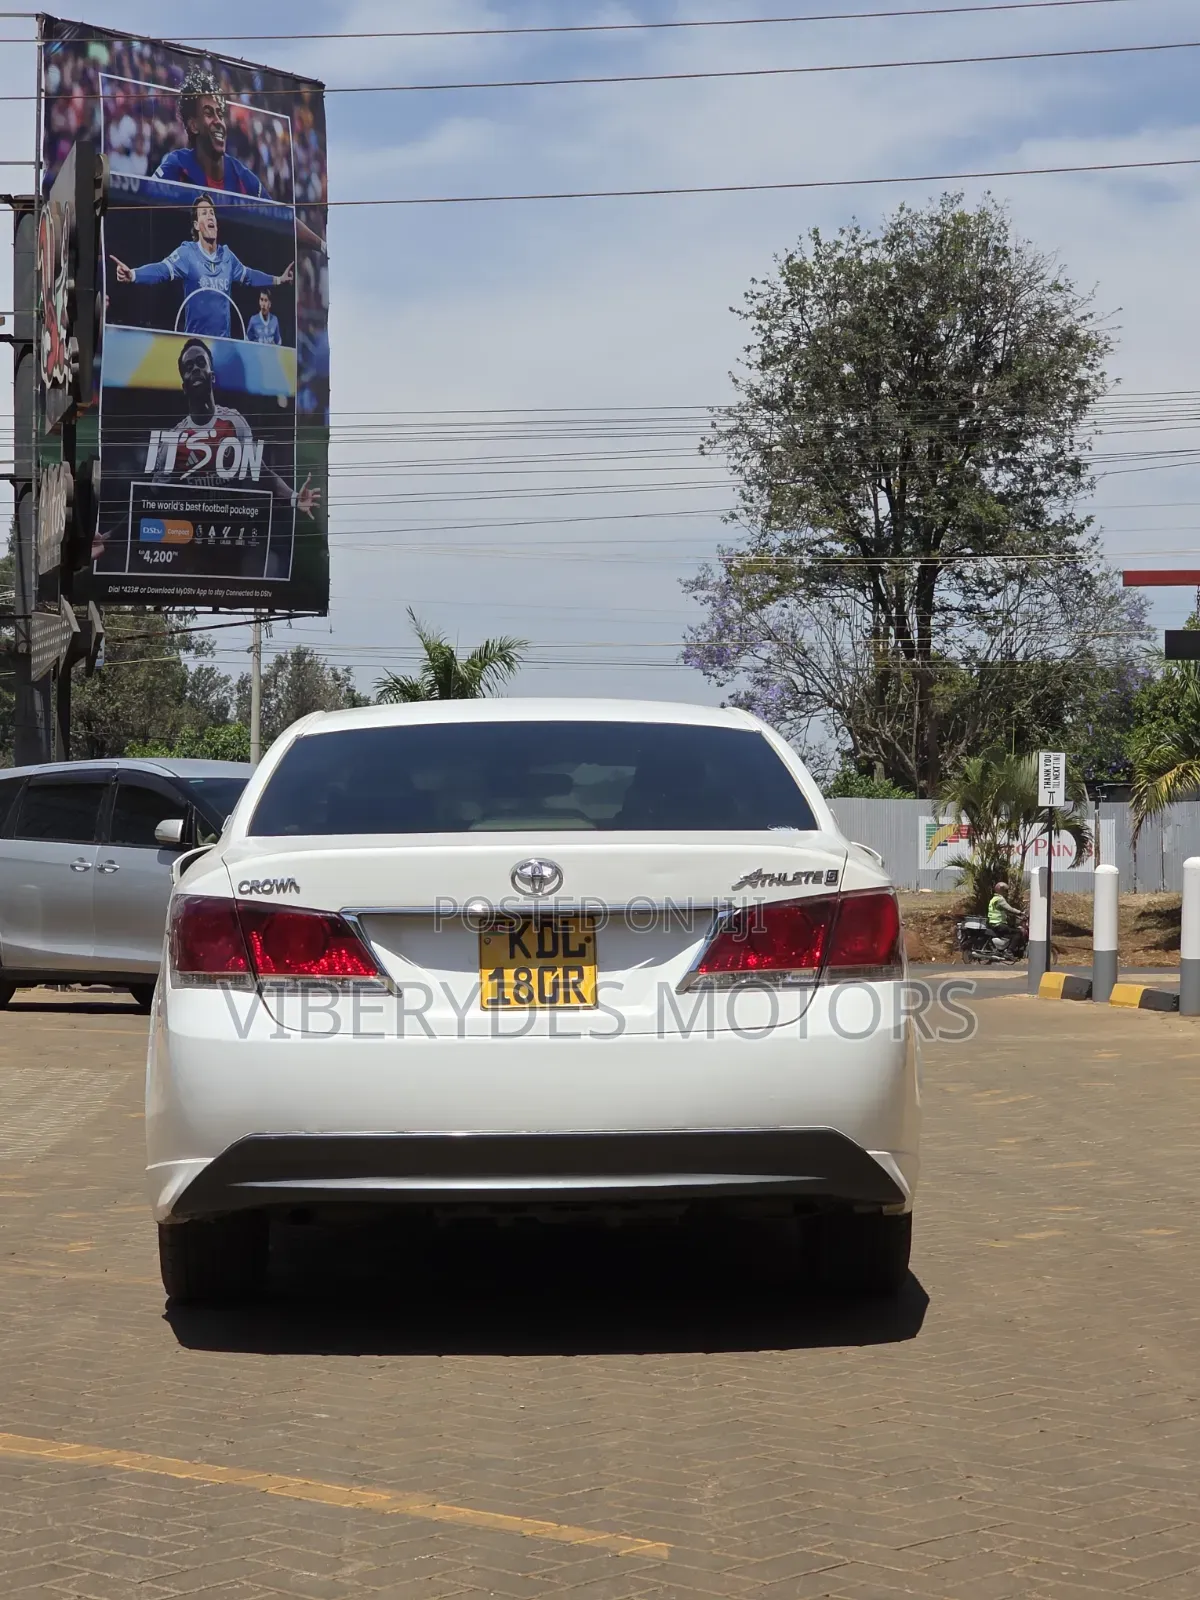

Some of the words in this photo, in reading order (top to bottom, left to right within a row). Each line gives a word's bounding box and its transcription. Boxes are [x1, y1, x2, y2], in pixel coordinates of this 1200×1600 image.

[144, 429, 217, 481] IT'S
[216, 437, 264, 482] ON
[141, 500, 156, 508] The
[158, 501, 184, 511] world's
[186, 502, 202, 512] best
[202, 502, 229, 514] football
[230, 506, 258, 518] package
[142, 526, 162, 534] DStv
[167, 528, 190, 536] Compact
[143, 550, 173, 564] 4,200
[146, 586, 176, 594] Download
[176, 588, 196, 596] MyDStv
[196, 588, 208, 596] App
[214, 590, 225, 598] stay
[226, 589, 254, 597] Connected
[260, 590, 272, 598] DStv
[1044, 754, 1052, 768] YOU
[1044, 768, 1052, 789] THANK
[1052, 766, 1060, 780] NEXT
[238, 878, 300, 895] CROWN
[508, 920, 586, 960] KDL
